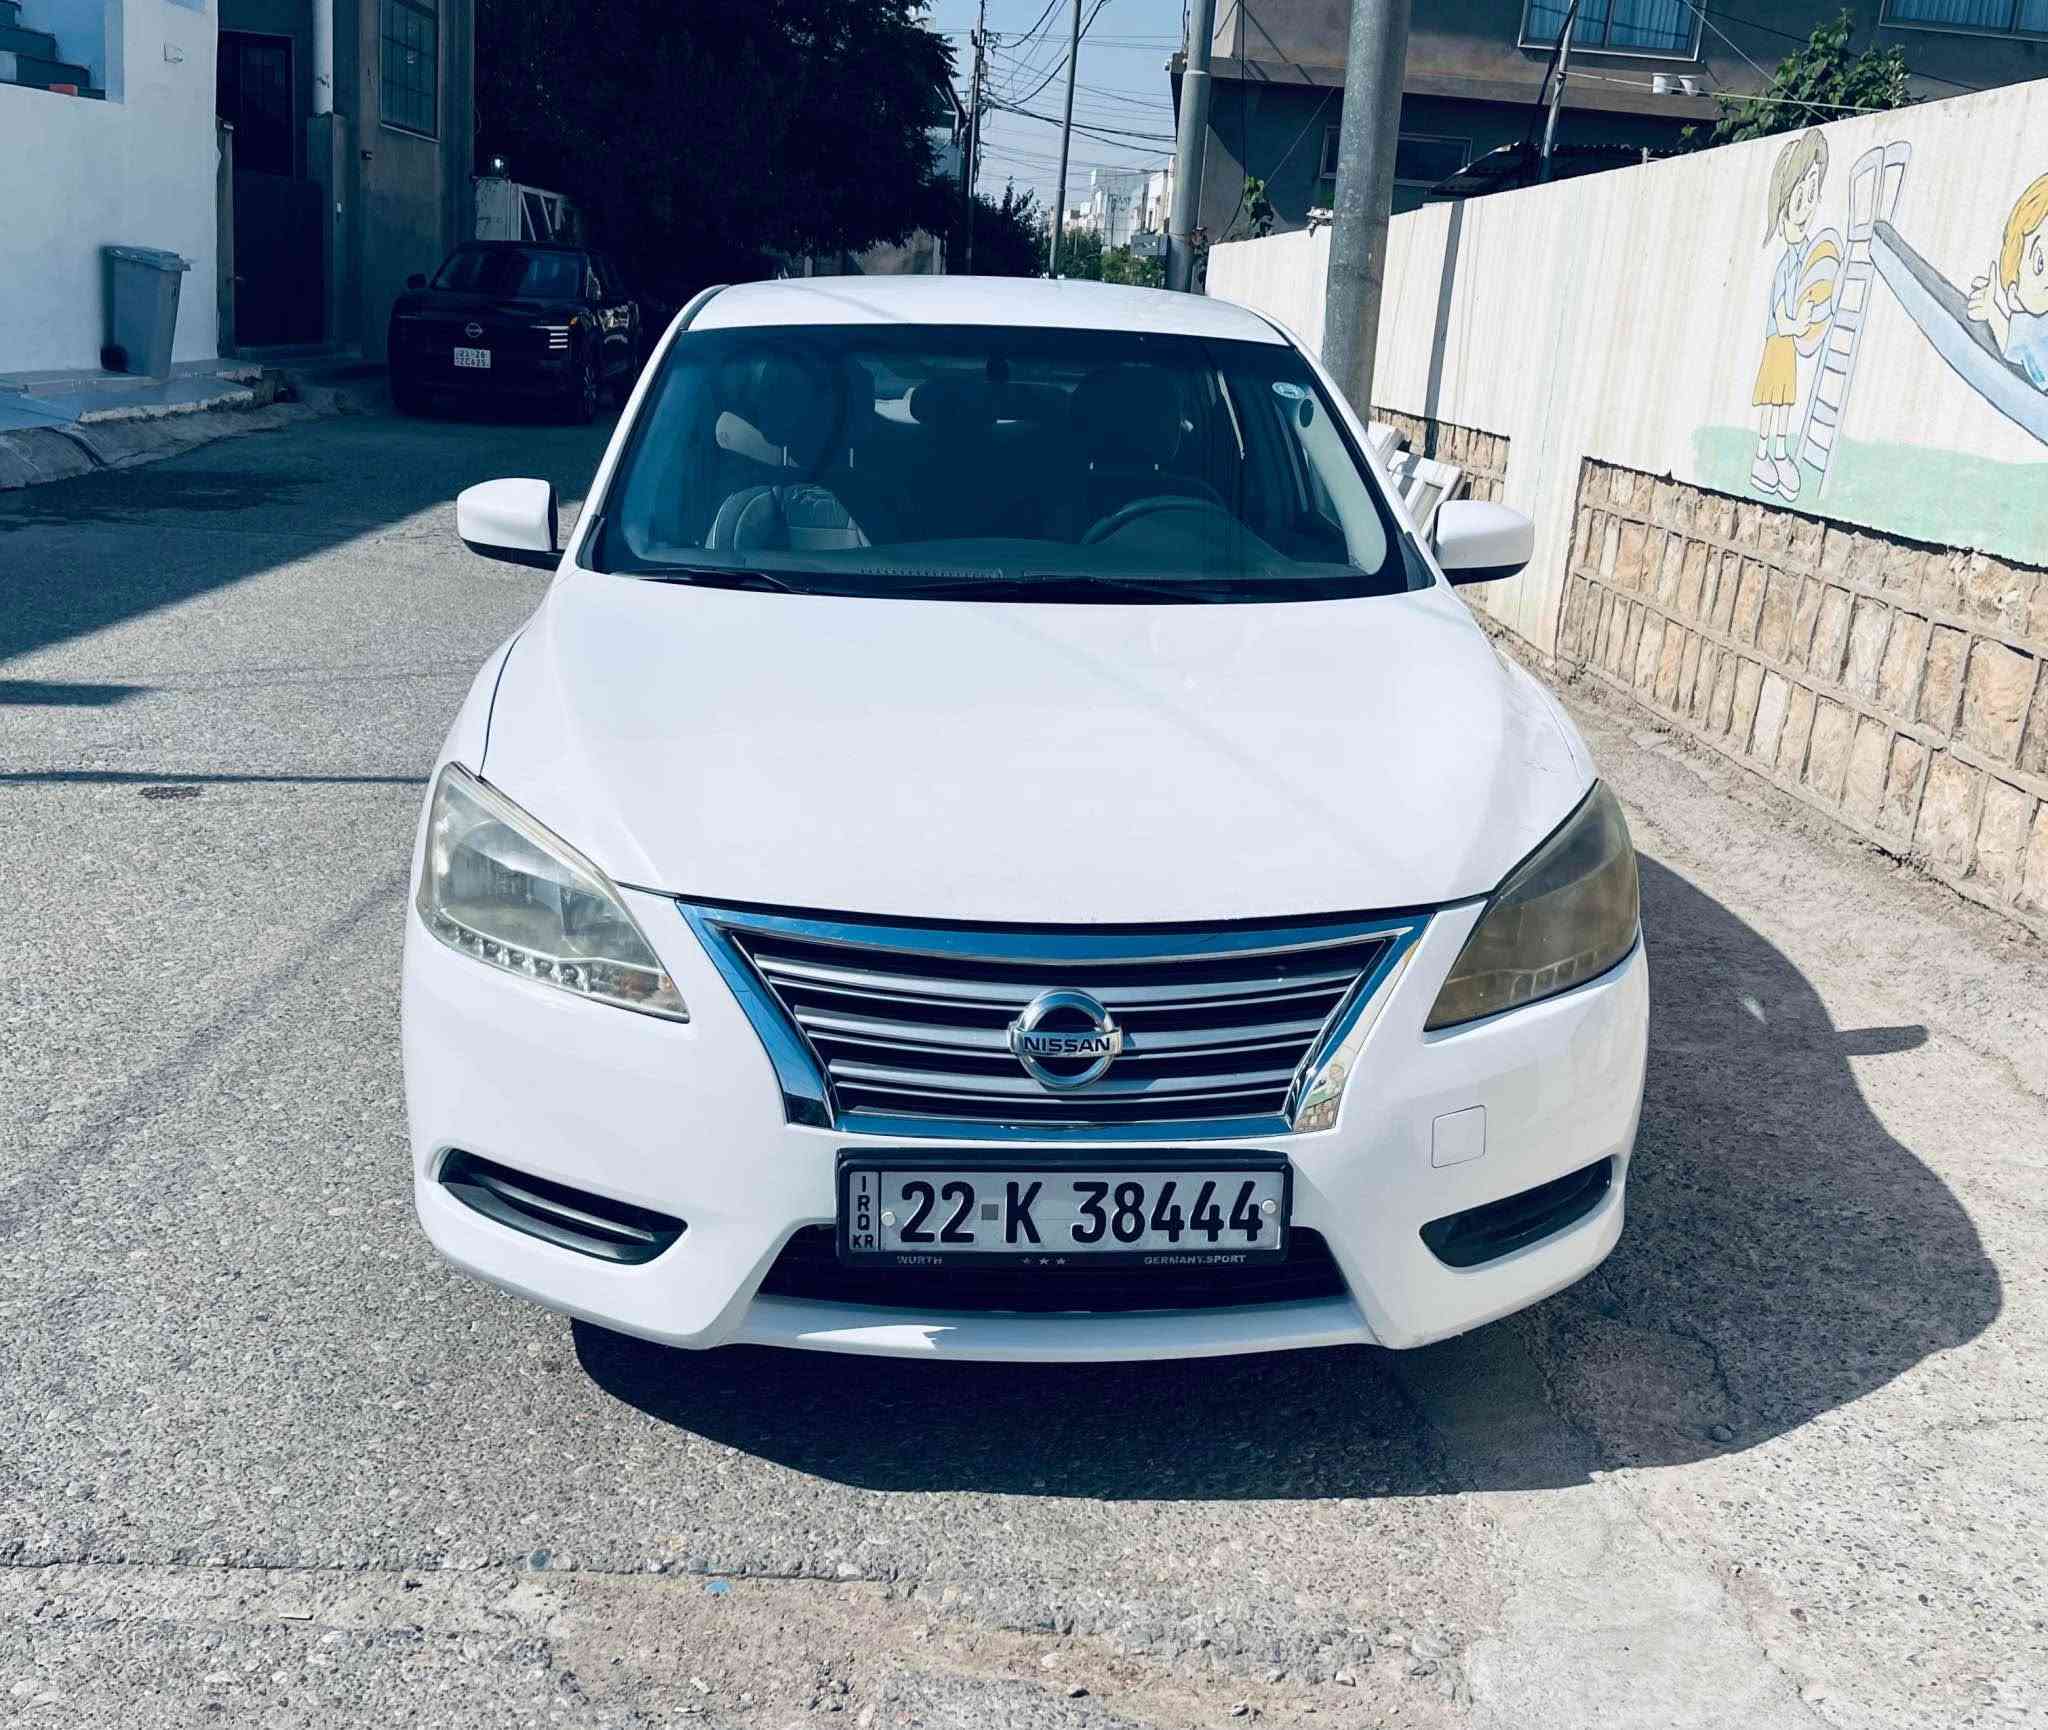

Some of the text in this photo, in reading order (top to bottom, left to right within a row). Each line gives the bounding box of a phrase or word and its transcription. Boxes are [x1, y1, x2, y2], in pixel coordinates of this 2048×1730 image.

[1023, 1037, 1110, 1053] NISSAN
[857, 1175, 871, 1232] IRQ
[900, 1180, 1264, 1243] 22 K 38444
[852, 1235, 875, 1249] KR
